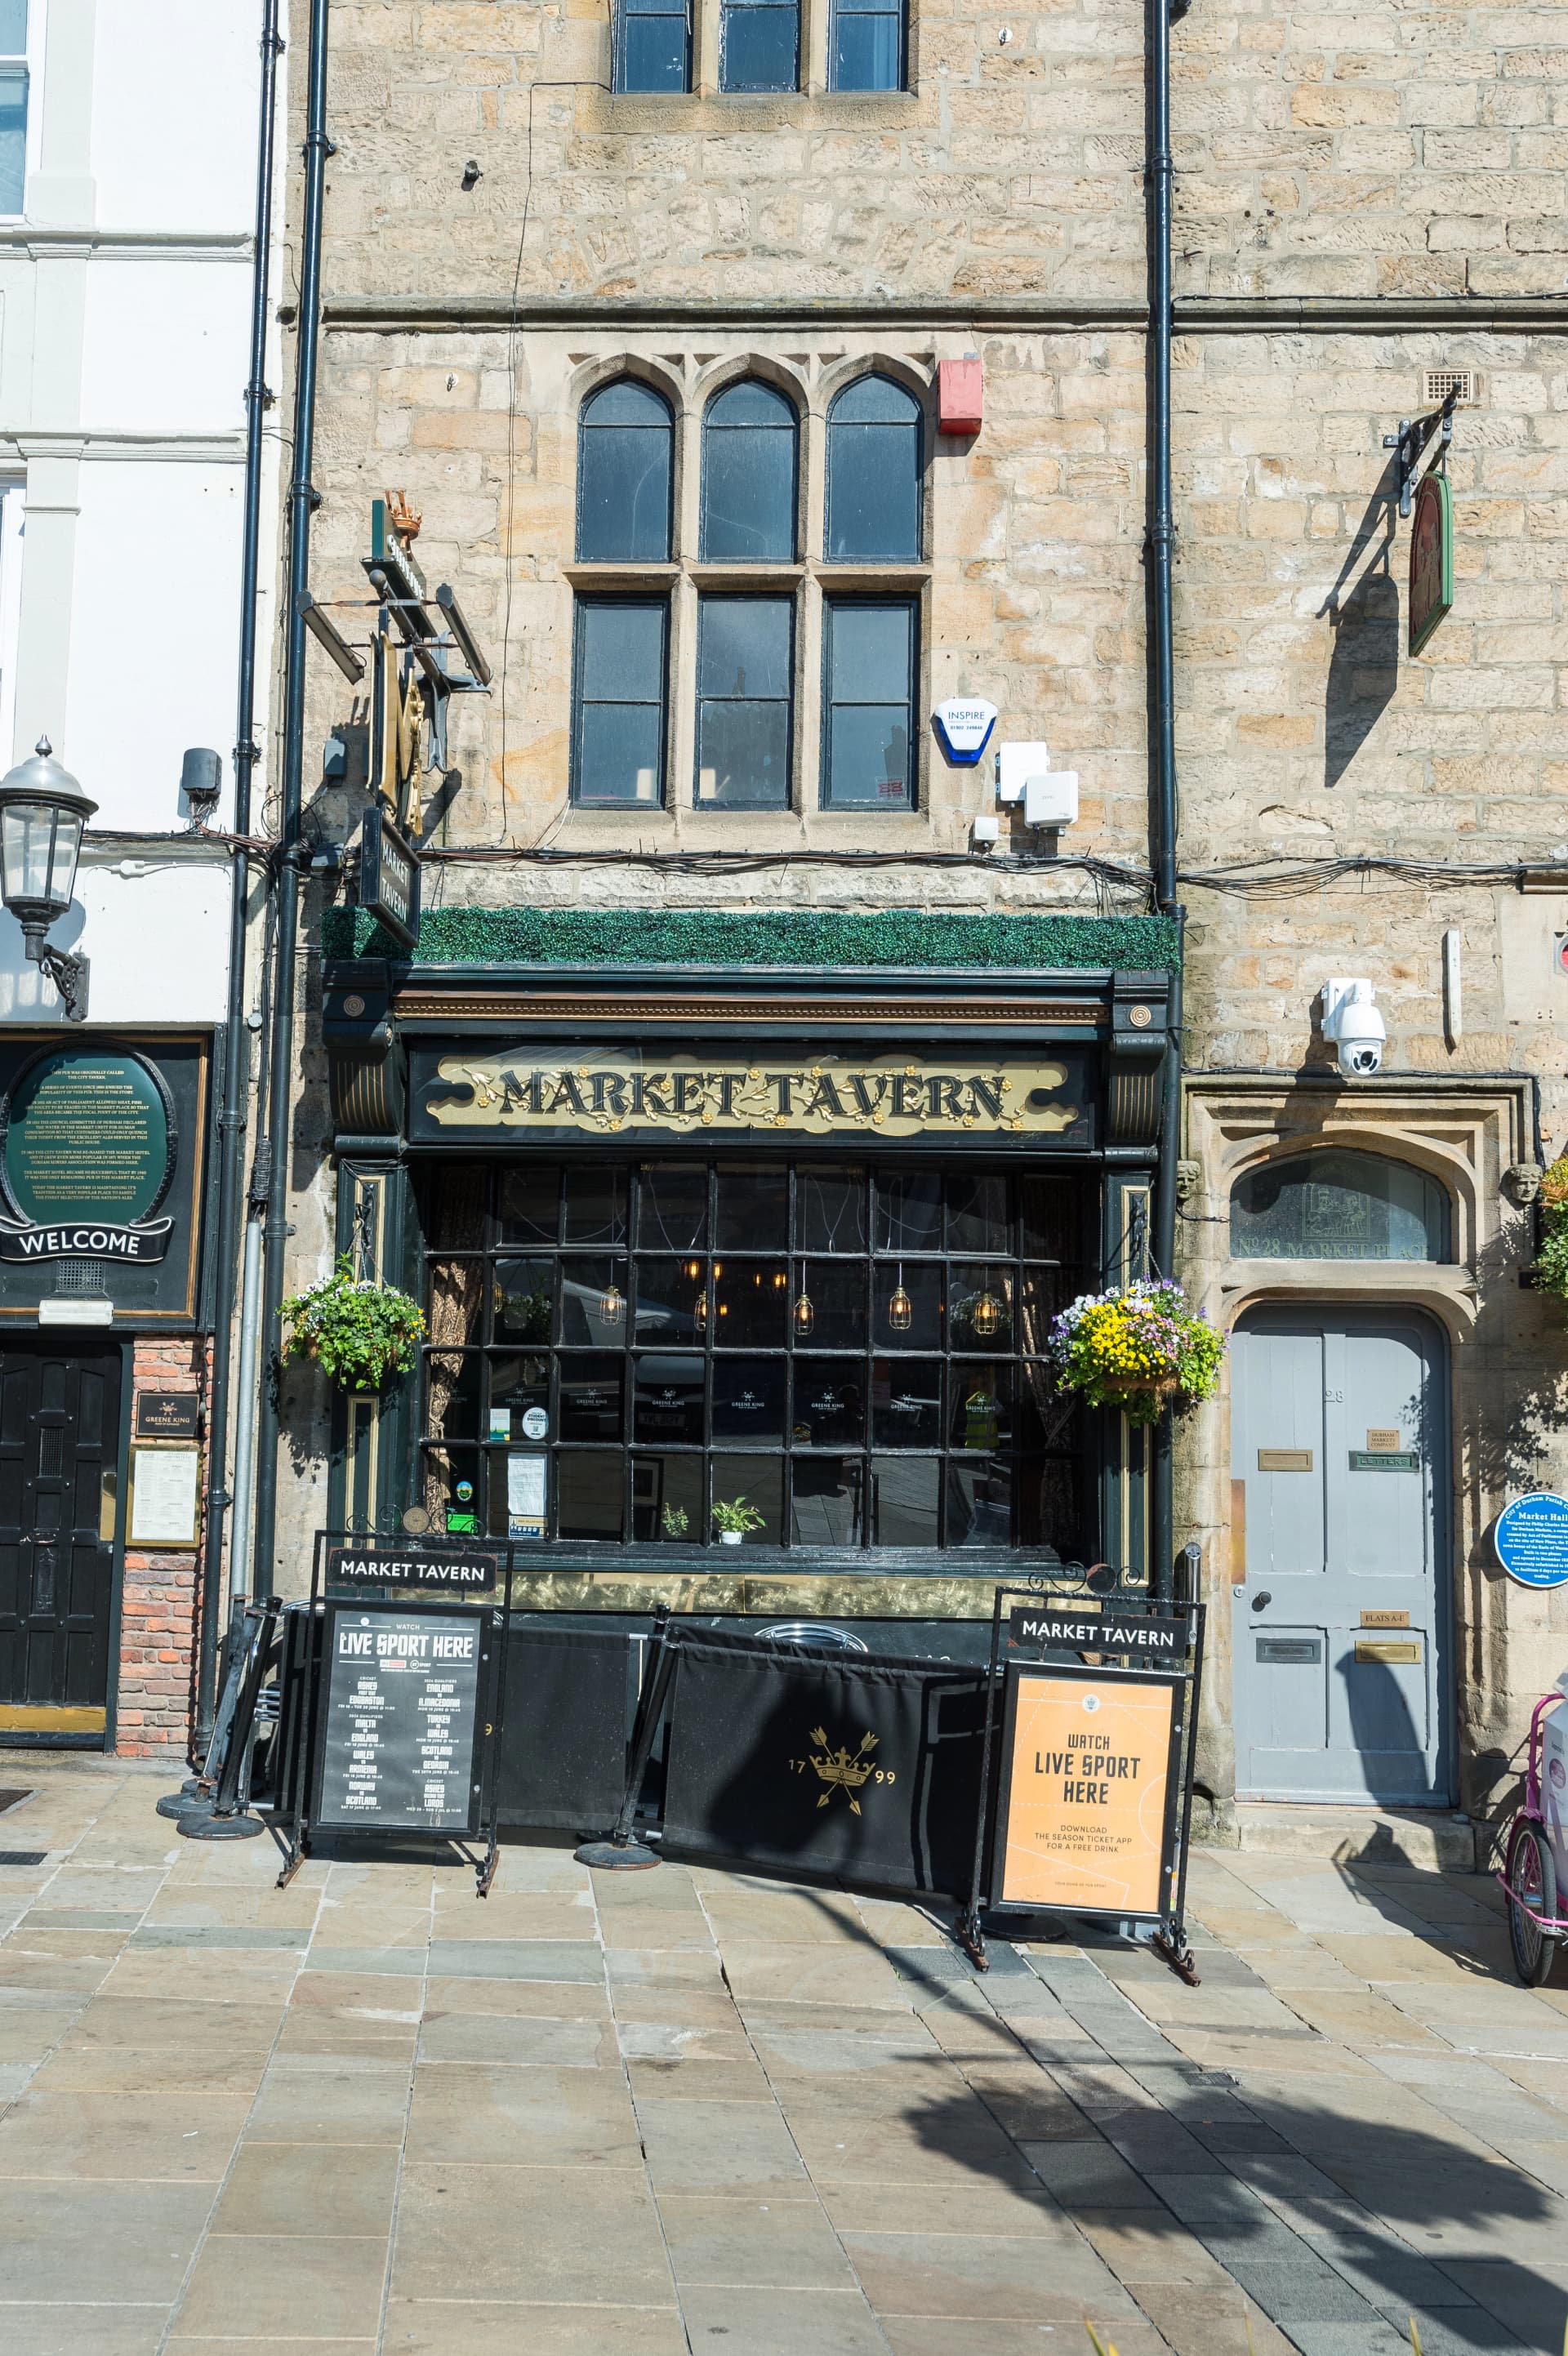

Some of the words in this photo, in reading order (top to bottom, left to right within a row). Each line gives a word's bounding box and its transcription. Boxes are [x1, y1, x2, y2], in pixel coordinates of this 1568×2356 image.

[948, 711, 985, 719] INSPIRE
[382, 840, 408, 887] MARKET
[382, 877, 407, 923] TAVERN
[499, 1069, 746, 1115] MARKET
[764, 1074, 1005, 1120] TAVERN
[18, 1230, 140, 1255] WELCOME
[1264, 1237, 1281, 1257] 28
[1286, 1242, 1367, 1258] MARKET
[1360, 1457, 1408, 1465] LETTERS
[1505, 1508, 1516, 1519] City
[1521, 1496, 1544, 1506] Durham
[1545, 1496, 1563, 1506] Parish
[1519, 1512, 1548, 1520] Market
[1550, 1513, 1568, 1521] Hall
[341, 1561, 412, 1578] MARKET
[416, 1564, 485, 1581] TAVERN
[1022, 1620, 1098, 1641] MARKET
[1102, 1627, 1174, 1646] TAVERN
[339, 1632, 373, 1655] LIVE
[376, 1633, 430, 1656] SPORT
[433, 1635, 473, 1658] HERE
[426, 1683, 454, 1693] ENGLAND
[354, 1719, 376, 1728] MALTA
[351, 1733, 379, 1743] ENGLAND
[427, 1728, 449, 1739] WALES
[1068, 1734, 1110, 1750] WATCH
[353, 1750, 375, 1760] WALES
[421, 1745, 453, 1756] SCOTLAND
[789, 1759, 806, 1774] 17
[875, 1770, 896, 1784] 99
[1035, 1752, 1074, 1775] LIVE
[1082, 1755, 1141, 1779] SPORT
[1063, 1780, 1109, 1804] HERE
[345, 1795, 377, 1806] SCOTLAND
[1060, 1824, 1107, 1833] DOWNLOAD
[1052, 1833, 1084, 1842] SEASON
[1087, 1835, 1114, 1843] TICKET
[1094, 1845, 1119, 1853] DRINK
